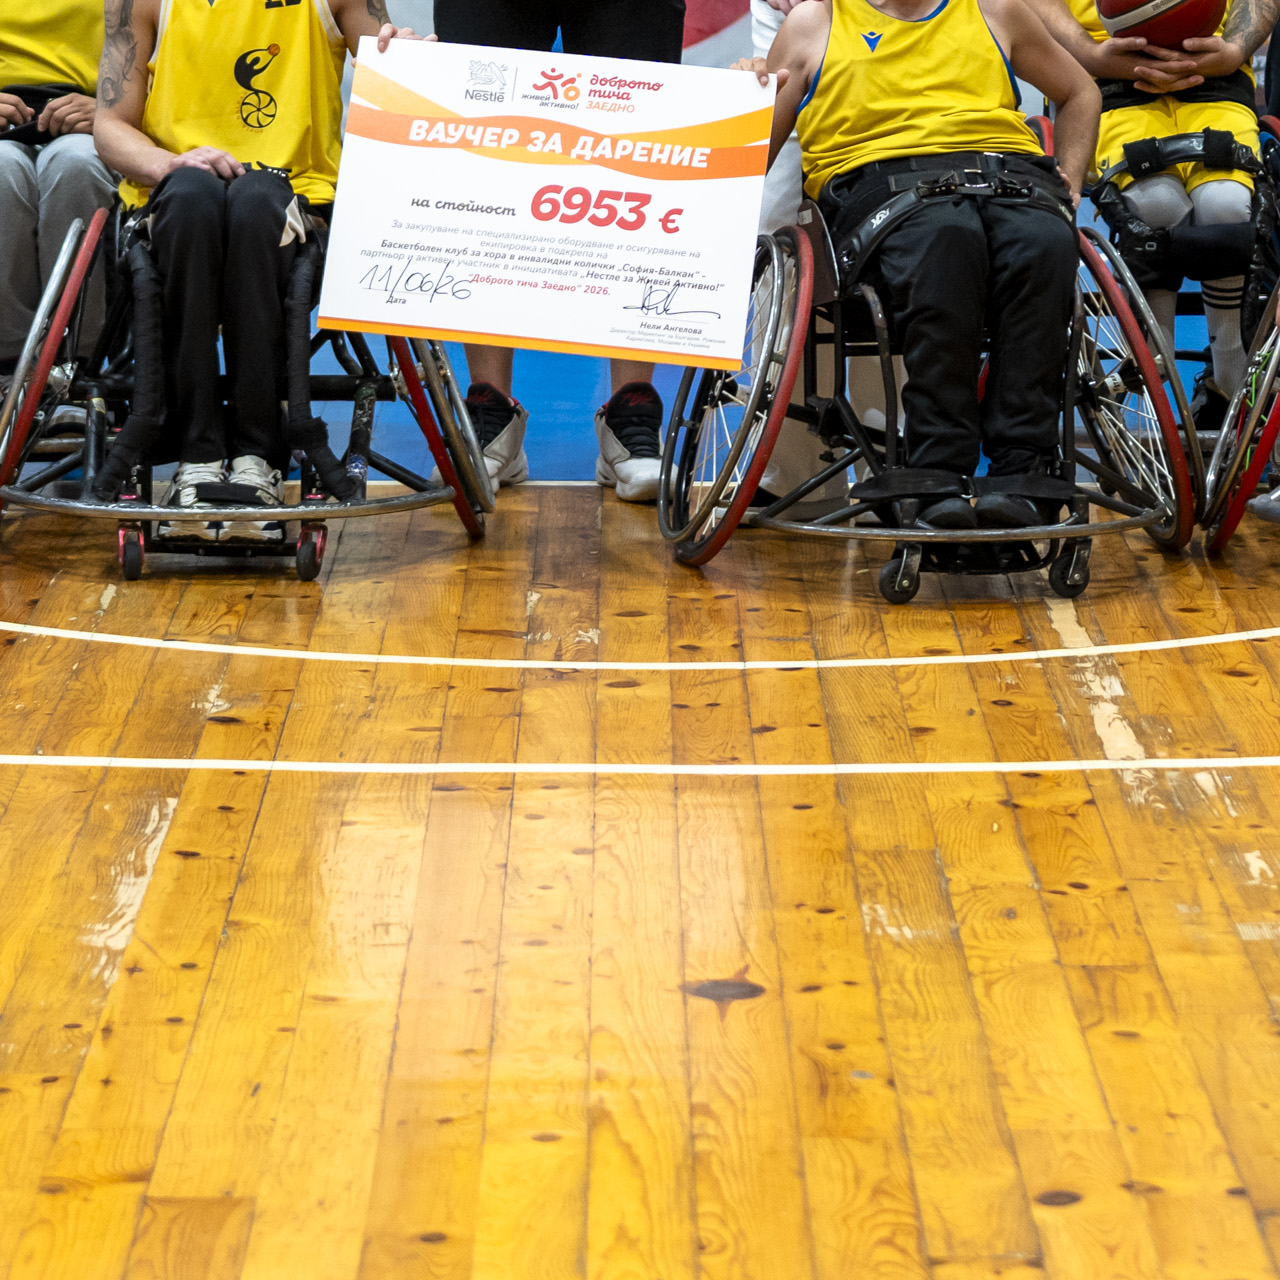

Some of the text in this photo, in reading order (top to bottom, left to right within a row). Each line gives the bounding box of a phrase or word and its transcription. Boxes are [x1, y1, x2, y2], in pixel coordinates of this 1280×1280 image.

[589, 74, 664, 92] доброто
[521, 93, 551, 101] живей
[588, 87, 632, 101] тича
[539, 101, 579, 110] активно!
[586, 101, 635, 113] ЗАЕДНО
[409, 119, 711, 169] ВАУЧЕР ЗА ДАРЕНИЕ
[410, 184, 684, 234] на стойност 6953 €
[391, 220, 403, 229] За
[405, 223, 459, 234] закупуване
[476, 230, 555, 244] специализирано
[558, 237, 615, 250] оборудване
[625, 244, 687, 257] осигуряване
[689, 251, 701, 259] на
[380, 240, 443, 253] Баскетболен
[445, 247, 469, 257] клуб
[483, 251, 507, 261] хора
[517, 254, 572, 266] инвалидни
[574, 261, 616, 271] колички
[480, 240, 537, 253] екипировка
[548, 247, 594, 260] подкрепа
[596, 252, 608, 260] на
[360, 249, 405, 261] партньор
[415, 255, 455, 265] активен
[456, 258, 501, 269] участник
[511, 264, 578, 278] инициативата
[622, 275, 634, 283] за
[636, 276, 670, 287] Живей
[517, 280, 538, 288] тича
[584, 285, 611, 296] 2026.
[385, 294, 407, 305] Дата
[640, 322, 703, 335] Нели Ангелова
